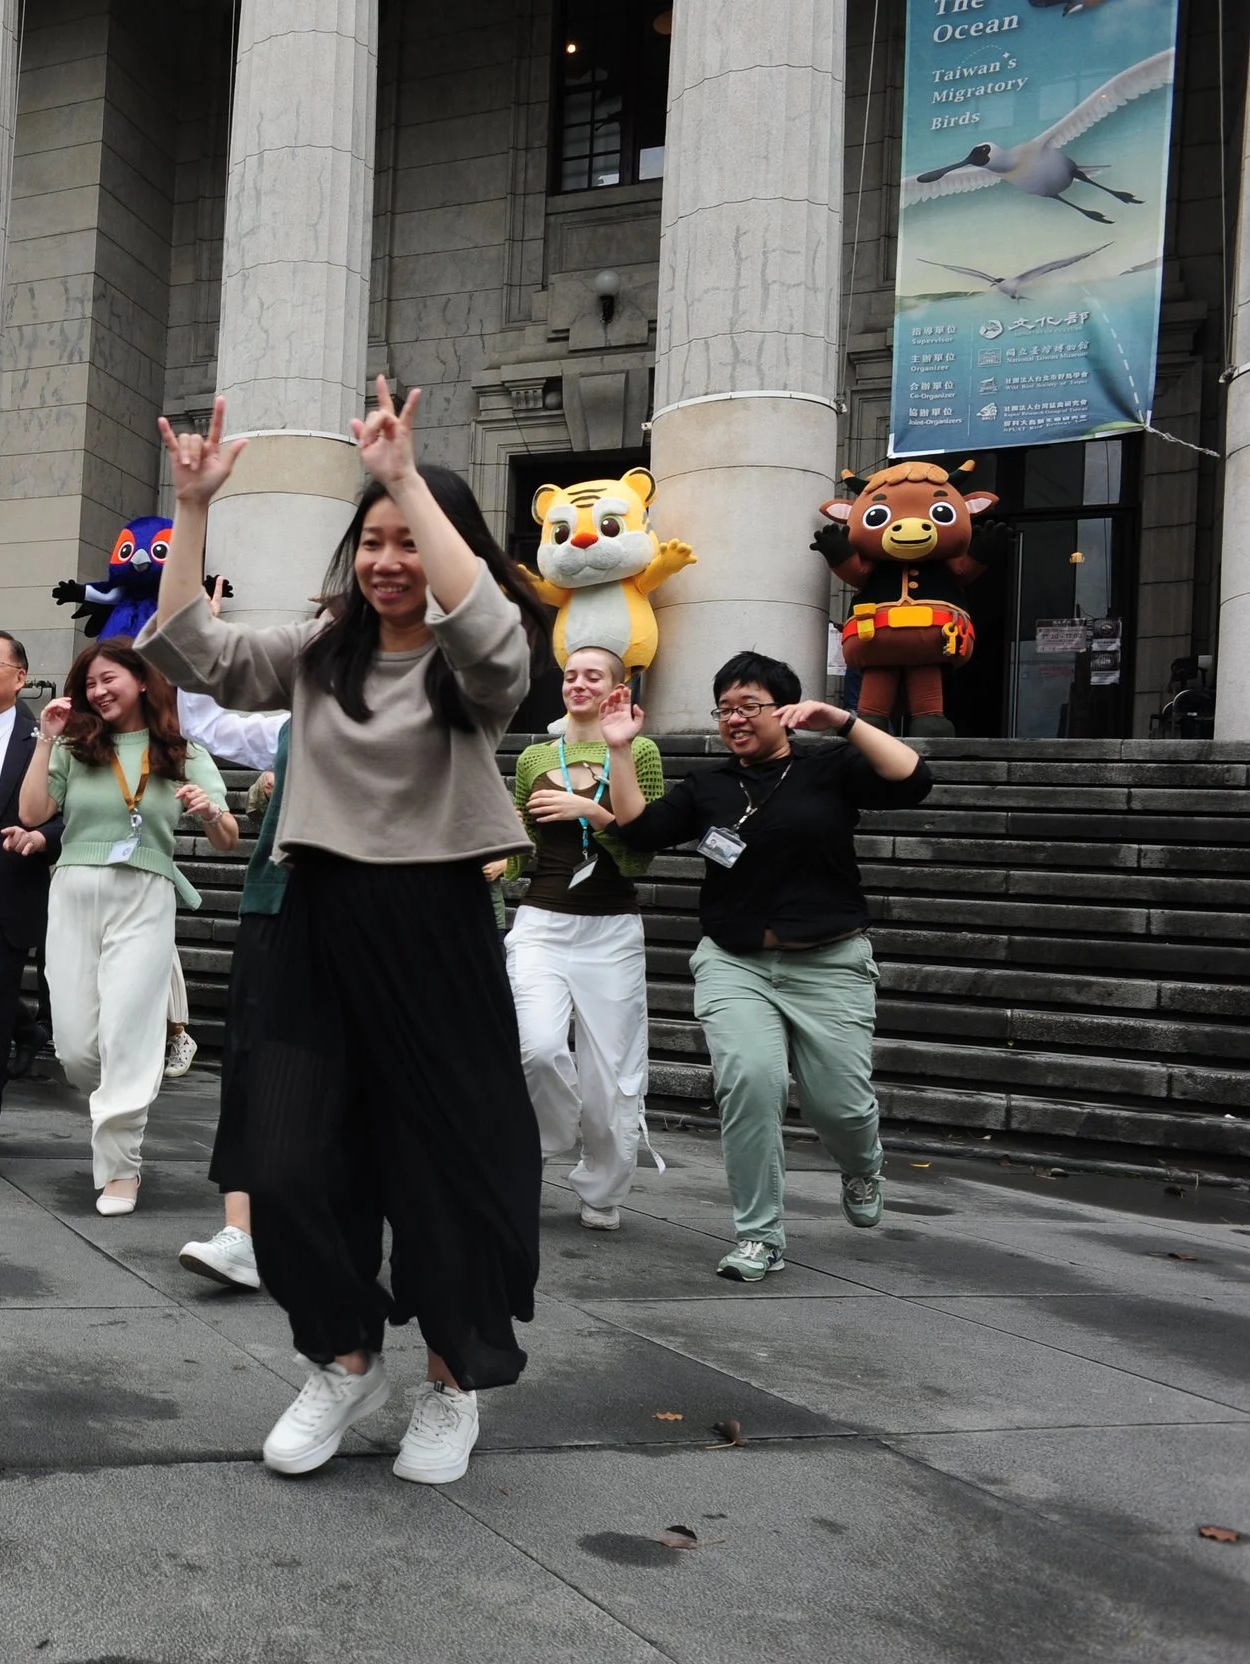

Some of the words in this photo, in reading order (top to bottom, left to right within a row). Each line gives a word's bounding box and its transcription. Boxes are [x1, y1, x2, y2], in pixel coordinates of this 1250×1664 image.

[933, 14, 1020, 43] Ocean
[931, 77, 1030, 104] Migratory
[930, 111, 981, 130] Birds
[1008, 311, 1090, 330] 文化部
[911, 325, 957, 336] 指導單位
[911, 336, 954, 345] Supervisor
[910, 352, 956, 363] 主辦單位
[910, 365, 949, 373] Organizer
[910, 380, 955, 391] 合辦單位
[909, 392, 956, 401] Co-Organizer
[909, 407, 954, 417] 協辦單位
[908, 418, 963, 426] Joint-Organizers
